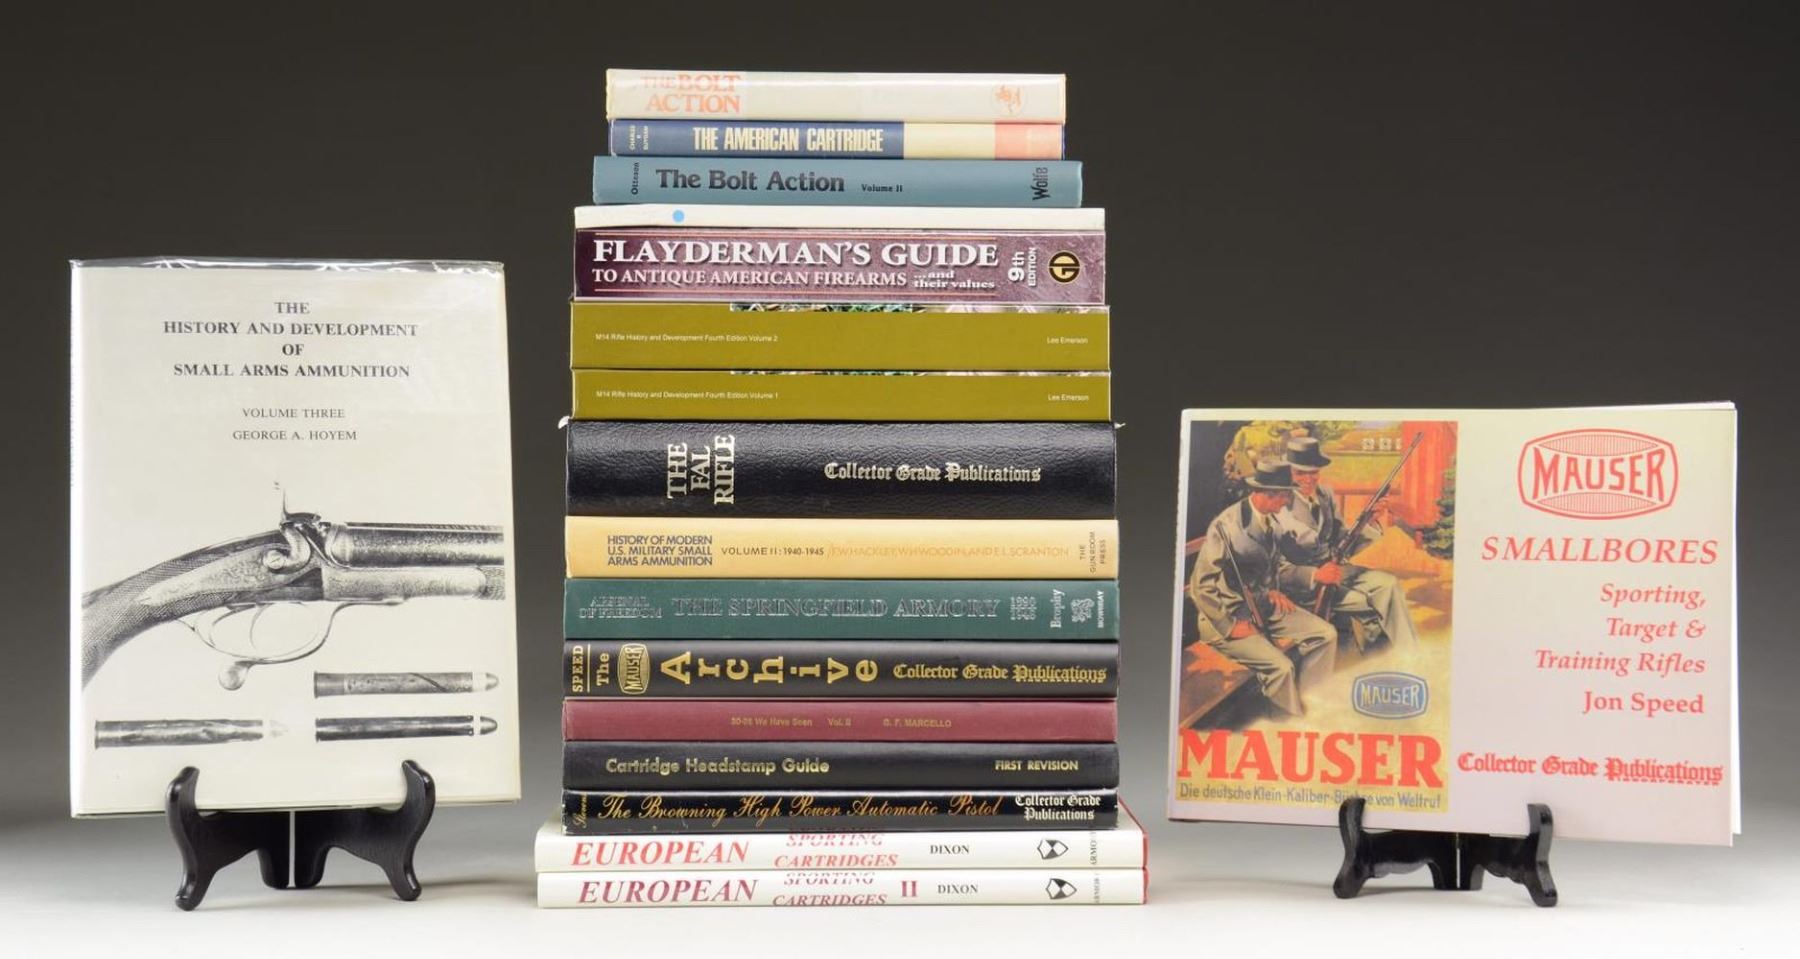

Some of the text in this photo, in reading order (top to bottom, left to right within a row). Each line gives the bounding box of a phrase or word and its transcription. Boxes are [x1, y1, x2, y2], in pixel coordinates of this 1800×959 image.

[641, 74, 742, 92] THE BOLT
[645, 94, 741, 113] ACTION
[692, 126, 884, 153] THE AMERICAN CARTRIDGE
[655, 168, 845, 193] The Bolt Action
[861, 183, 903, 193] Volume II
[1031, 167, 1051, 201] Wolfe
[592, 239, 999, 268] FLAYDERMAN'S GUIDE
[1007, 251, 1026, 283] 9th
[1027, 247, 1038, 288] EDITION
[592, 268, 907, 287] TO ANTIQUE AMERICAN FIREARMS
[913, 279, 995, 290] their values
[275, 302, 310, 315] THE
[163, 320, 418, 337] HISTORY AND DEVELOPMENT
[610, 333, 625, 342] Rifle
[626, 333, 648, 344] History
[649, 333, 662, 342] and
[663, 333, 704, 344] Development
[704, 333, 725, 342] Fourth
[726, 333, 748, 342] Edition
[749, 333, 771, 342] Volume
[772, 334, 778, 343] 2
[1047, 336, 1088, 345] Lee Emerson
[281, 343, 305, 356] OF
[173, 363, 411, 379] SMALL ARMS AMMUNITION
[596, 390, 779, 401] M14 Rifle History and Development Fourth Edition Volume 1
[1048, 393, 1089, 402] Lee Emerson
[242, 407, 346, 419] VOLUME THREE
[232, 429, 357, 442] GEORGE A. HOYEM
[667, 442, 687, 499] THE
[690, 445, 711, 491] FAL
[714, 433, 735, 505] RIFLE
[824, 461, 1041, 483] Collector Grade Publications
[1532, 446, 1666, 503] MAUSER
[607, 534, 712, 546] HISTORY OF MODERN
[607, 546, 712, 556] U.S. MILITARY SMALL
[721, 547, 768, 556] VOLUME
[783, 547, 824, 556] 1940-1945
[1079, 544, 1087, 561] THE
[1481, 536, 1718, 565] SMALLBORES
[607, 556, 713, 567] ARMS AMMUNITION
[1600, 582, 1706, 610] Sporting,
[598, 607, 662, 618] FREEDOM
[672, 598, 723, 617] THE
[727, 598, 888, 617] SPRINGFIELD
[893, 598, 1001, 618] ARMORY
[1050, 589, 1065, 629] Brophy
[1606, 617, 1706, 643] Target &
[572, 644, 584, 693] SPEED
[596, 652, 610, 686] The
[623, 644, 645, 692] MAUSER
[660, 650, 878, 687] Archive
[1535, 649, 1706, 678] Training Rifles
[893, 663, 1107, 684] Collector Grade Publications
[1360, 681, 1420, 709] MAUSER
[1583, 691, 1704, 717] Jon Speed
[769, 717, 790, 727] Have
[792, 718, 813, 727] Seen
[904, 718, 952, 728] MARCELLO
[606, 757, 830, 776] Cartridge Headstamp Guide
[994, 760, 1079, 771] FIRST REVISION
[1177, 728, 1443, 788] MAUSER
[1457, 752, 1723, 782] Collector Grade Publications
[1014, 794, 1101, 808] Collector Grade
[1180, 782, 1200, 798] Die
[1202, 784, 1252, 801] deutsche
[1376, 794, 1395, 807] von
[597, 795, 632, 819] The
[638, 793, 728, 829] Browning
[733, 793, 783, 829] High
[788, 794, 841, 818] Power
[846, 794, 939, 817] Automatic
[947, 793, 1003, 817] Pistol
[1023, 806, 1095, 822] Publications
[571, 840, 750, 867] EUROPEAN
[929, 844, 971, 855] DIXON
[774, 854, 899, 869] CARTRIDGES
[578, 879, 759, 904] EUROPEAN
[901, 880, 917, 898] II
[937, 884, 978, 895] DIXON
[773, 894, 888, 907] CARTRIDGES
